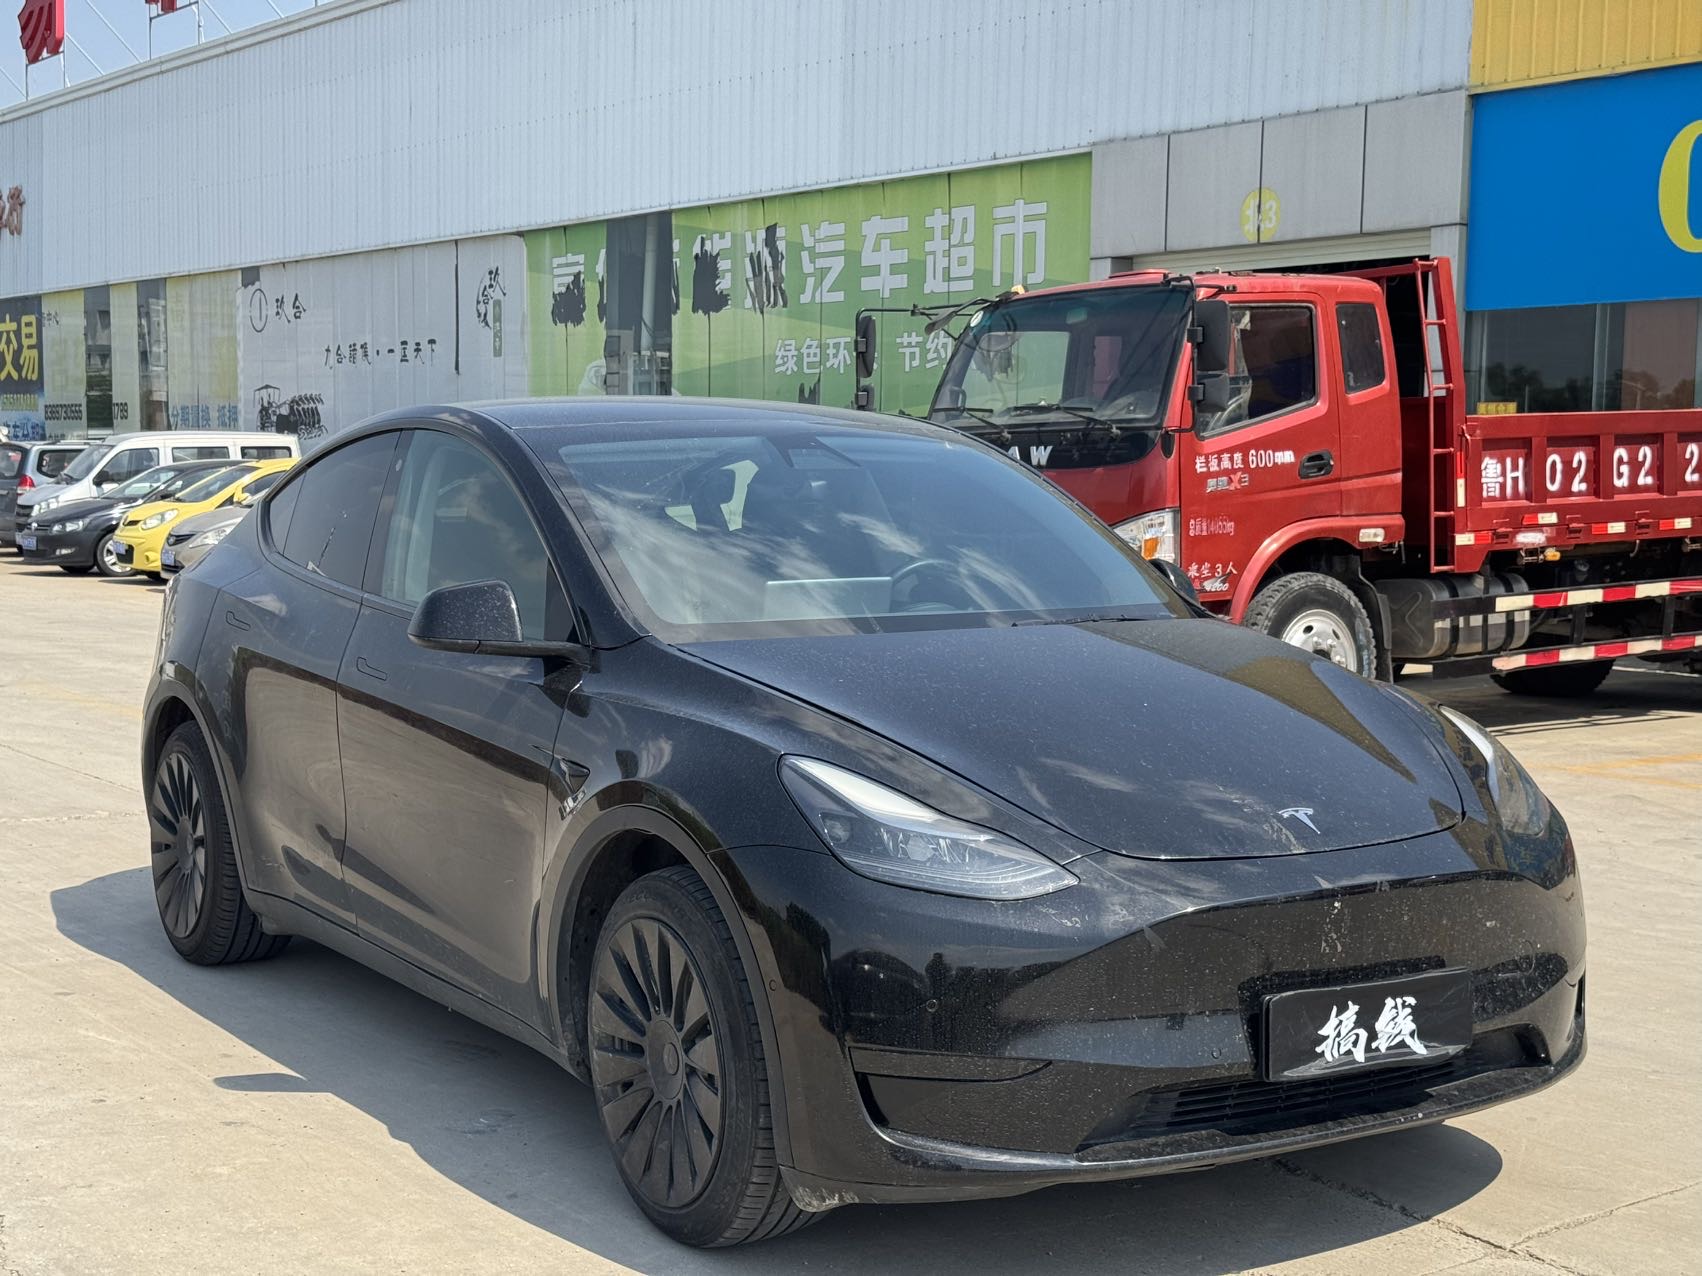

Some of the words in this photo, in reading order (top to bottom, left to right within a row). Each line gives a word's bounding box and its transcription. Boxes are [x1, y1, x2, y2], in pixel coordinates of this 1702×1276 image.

[0, 313, 39, 381] 交易
[775, 336, 878, 375] 绿色环
[1195, 452, 1244, 473] 栏板高度
[1248, 449, 1296, 468] 600mm
